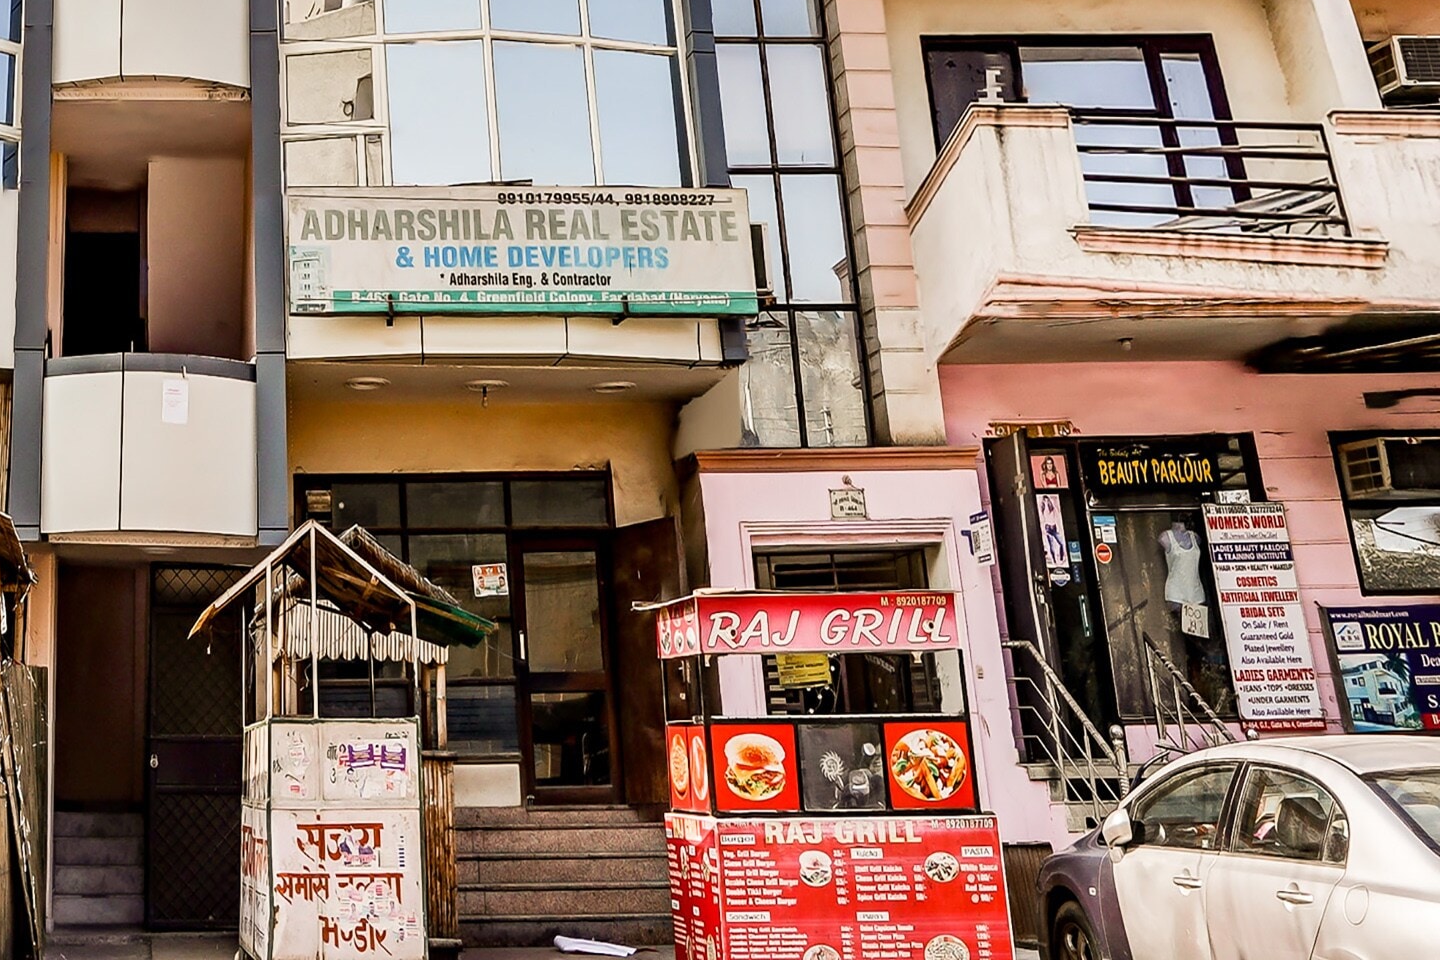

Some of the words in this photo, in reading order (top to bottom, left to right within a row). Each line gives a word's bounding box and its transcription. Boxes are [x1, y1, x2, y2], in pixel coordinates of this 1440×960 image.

[301, 209, 513, 241] ADHARSHILA
[526, 209, 610, 240] REAL
[621, 209, 739, 241] ESTATE
[395, 247, 415, 268] &
[424, 247, 498, 268] HOME
[508, 246, 669, 269] DEVELOPERS
[449, 272, 508, 287] Adharshila
[512, 272, 538, 288] Eng.
[541, 273, 550, 286] &
[552, 272, 611, 287] Contractor
[399, 291, 430, 302] Gate
[476, 291, 545, 302] Greenfield
[1098, 459, 1147, 485] BEAUTY
[1151, 457, 1213, 484] PARLOUR
[1208, 516, 1250, 530] WOMENS
[1251, 515, 1285, 528] WORLD
[1235, 544, 1258, 552] BEAUTY
[1236, 576, 1278, 587] COSMETICS
[896, 596, 946, 606] 8920187709
[1221, 592, 1259, 602] ARTIFICIAL
[1261, 591, 1298, 601] JEWELLERY
[1240, 607, 1267, 618] BRIDAL
[1268, 607, 1285, 617] SETS
[707, 610, 801, 649] RAJ
[820, 608, 951, 645] GRILL
[1253, 621, 1266, 629] Sale
[1279, 632, 1294, 640] Gold
[1364, 622, 1430, 649] ROYAL
[1257, 656, 1284, 664] Available
[1234, 670, 1265, 681] LADIES
[1267, 668, 1315, 681] GARMENTS
[1267, 708, 1294, 716] Available
[946, 819, 993, 828] 8920187709
[765, 822, 822, 844] RAJ
[834, 820, 922, 844] GRILL
